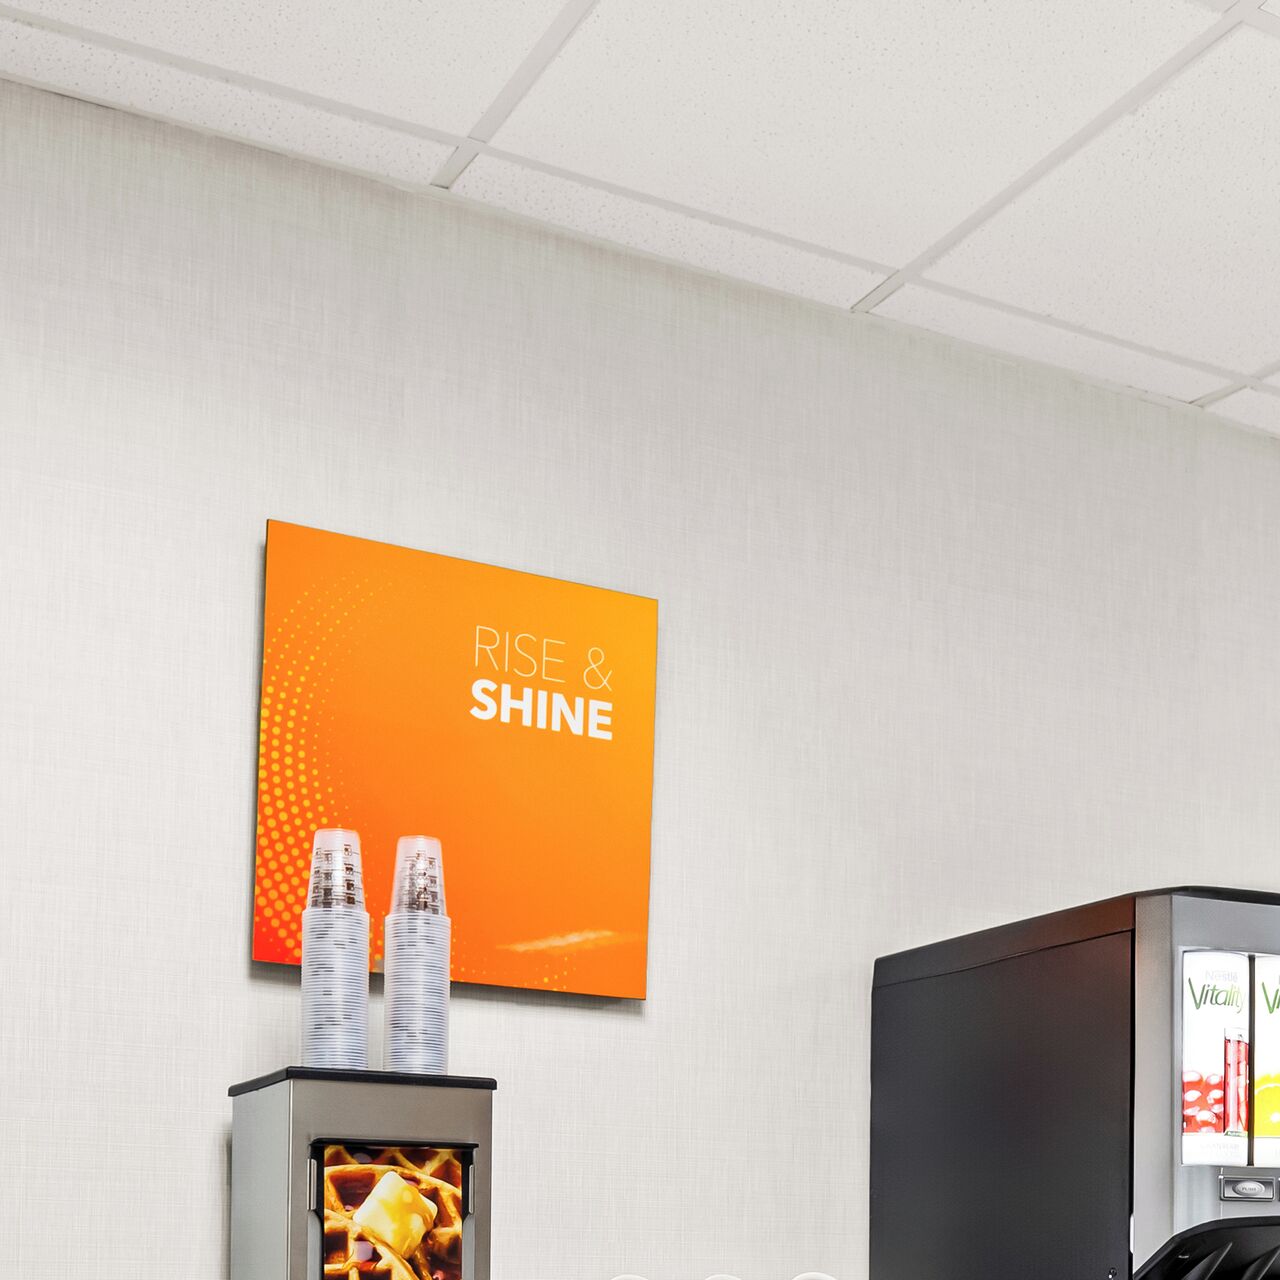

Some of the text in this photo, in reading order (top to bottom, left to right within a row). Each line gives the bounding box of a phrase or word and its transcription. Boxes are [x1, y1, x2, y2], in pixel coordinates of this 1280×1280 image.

[475, 624, 613, 692] RISE &
[470, 678, 613, 741] SHINE
[1188, 976, 1246, 1014] Vitality
